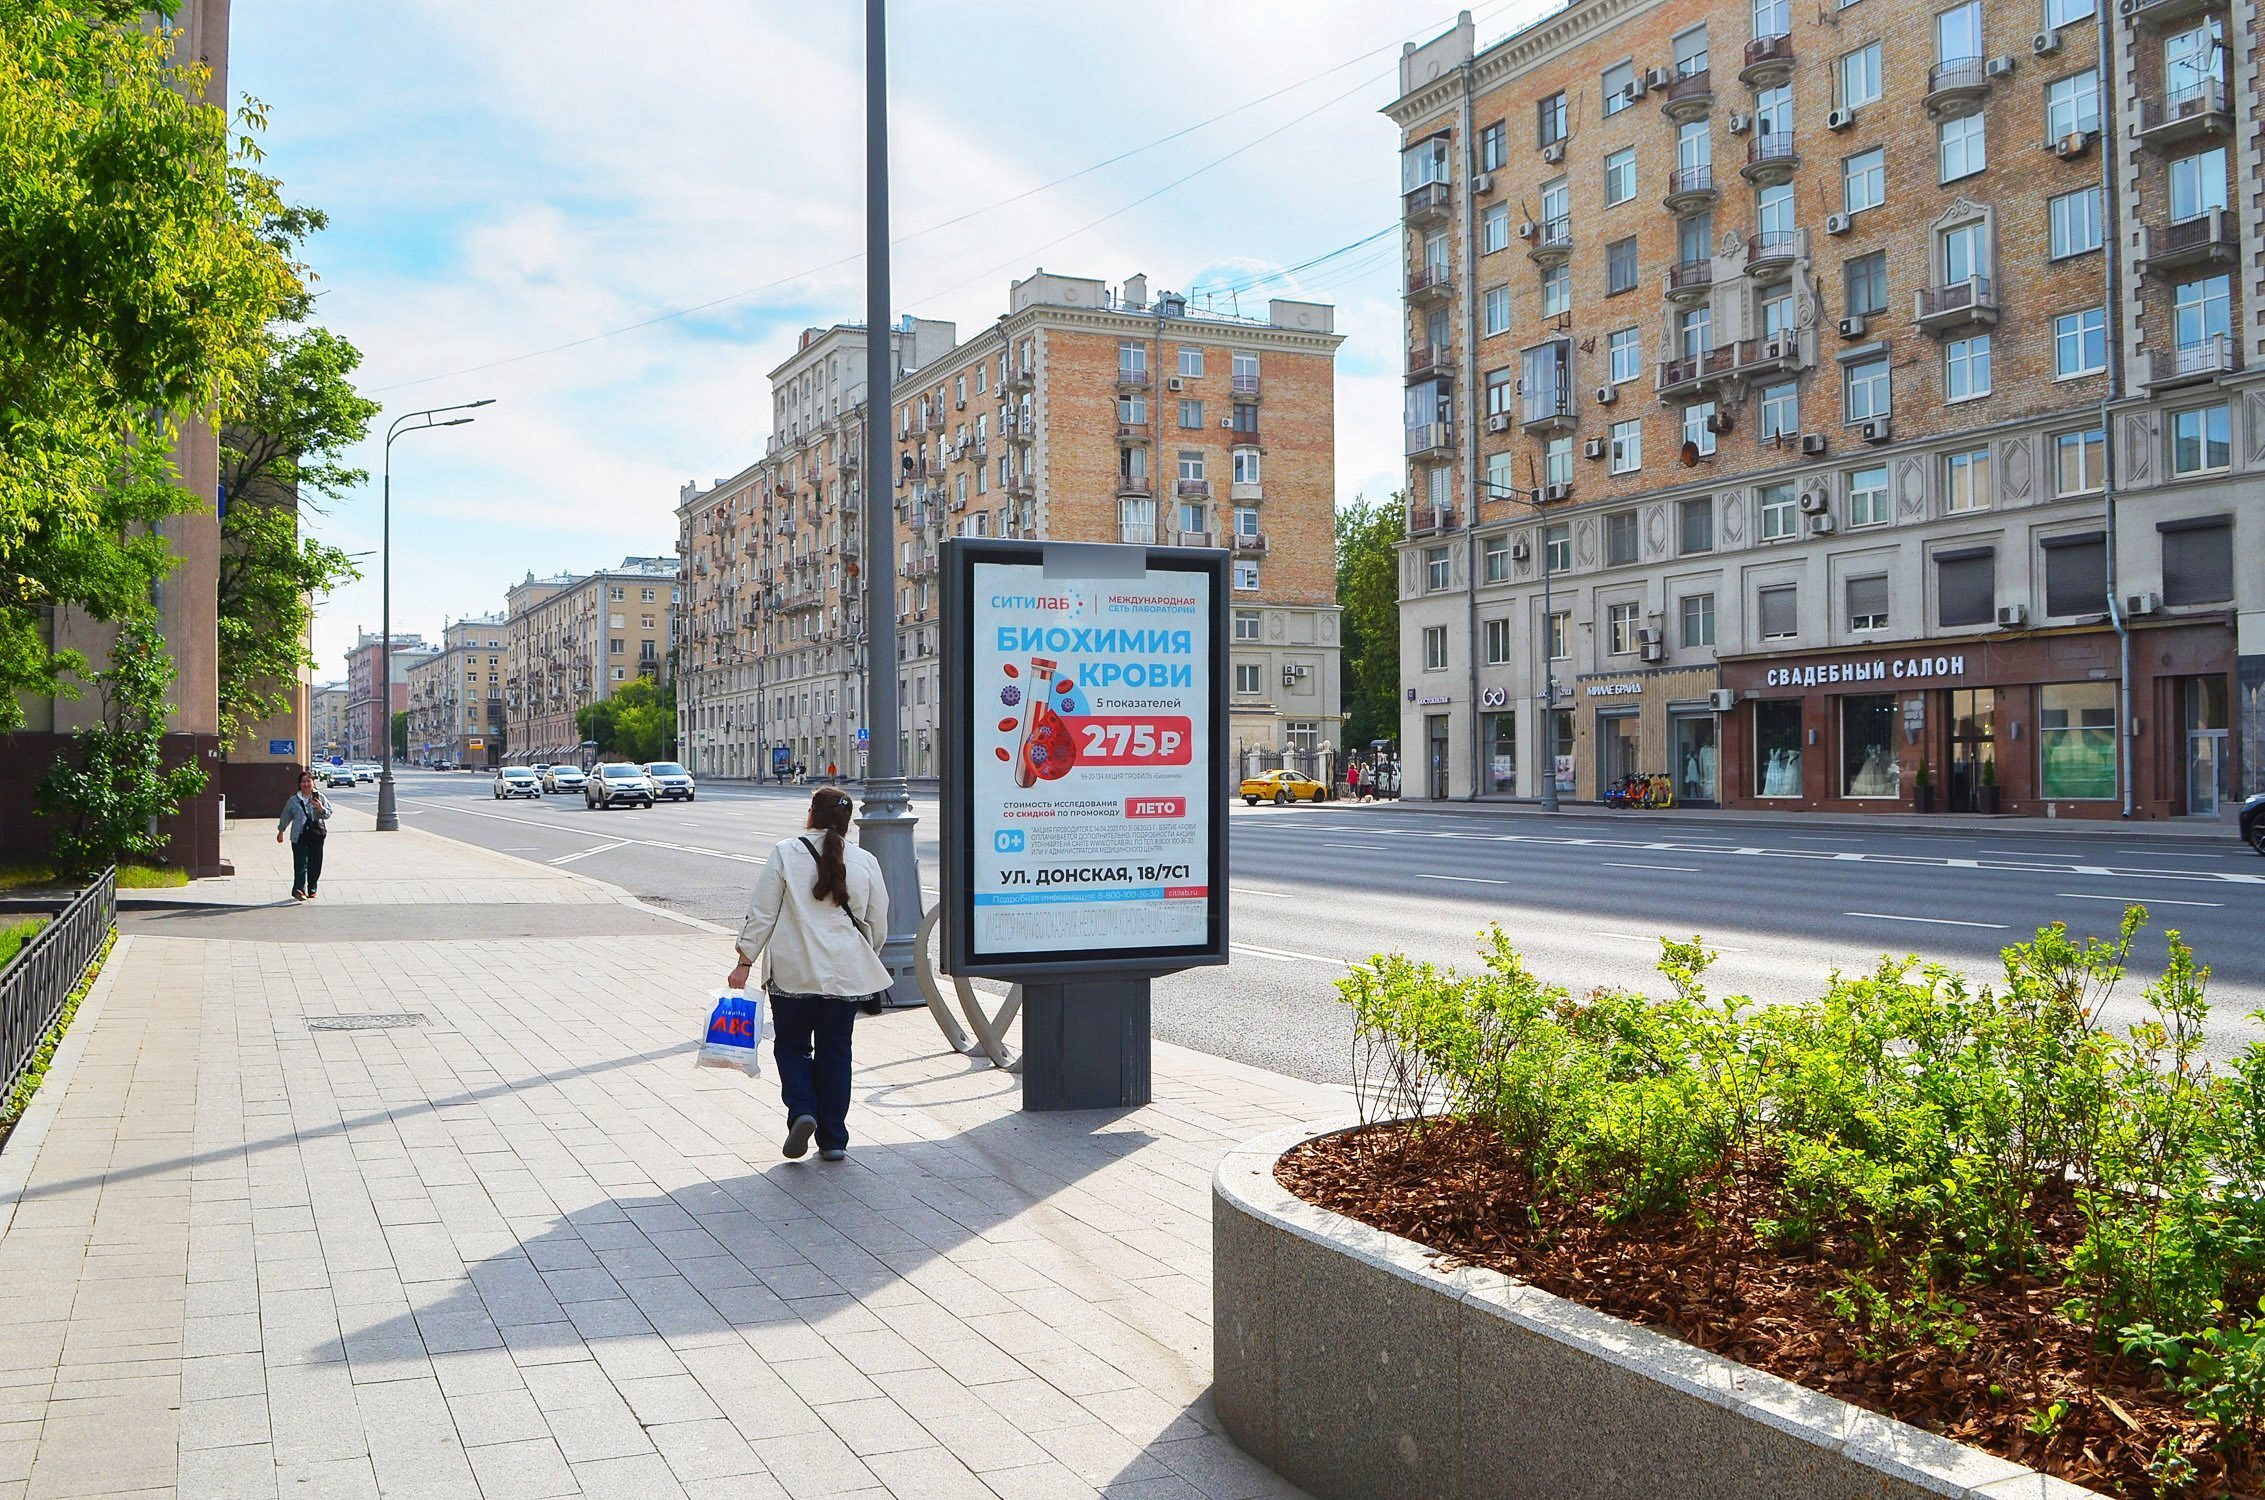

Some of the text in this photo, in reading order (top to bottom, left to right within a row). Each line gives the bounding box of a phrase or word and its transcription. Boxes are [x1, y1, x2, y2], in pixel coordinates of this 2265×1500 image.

[1108, 596, 1196, 606] МЕЖДУНАРОДНАЯ
[1108, 604, 1130, 613] СЕТЬ
[997, 626, 1191, 654] БИОХИМИЯ
[1079, 663, 1192, 688] КРОВИ
[1767, 656, 1965, 687] СВАДЕБНЫЙ САЛОН
[1096, 697, 1181, 709] 5 показателей
[1125, 772, 1153, 780] ПРОФИЛЬ
[1003, 800, 1118, 809] СТОИМОСТЬ ИССЛЕДОВАНИЯ
[1135, 802, 1176, 815] ЛЕТО
[1016, 810, 1056, 818] СКИДКОЙ
[1070, 809, 1120, 818] ПРОМОКОДУ
[997, 832, 1022, 849] 0+
[1000, 869, 1031, 885] УЛ.
[1036, 866, 1133, 885] ДОНСКАЯ,
